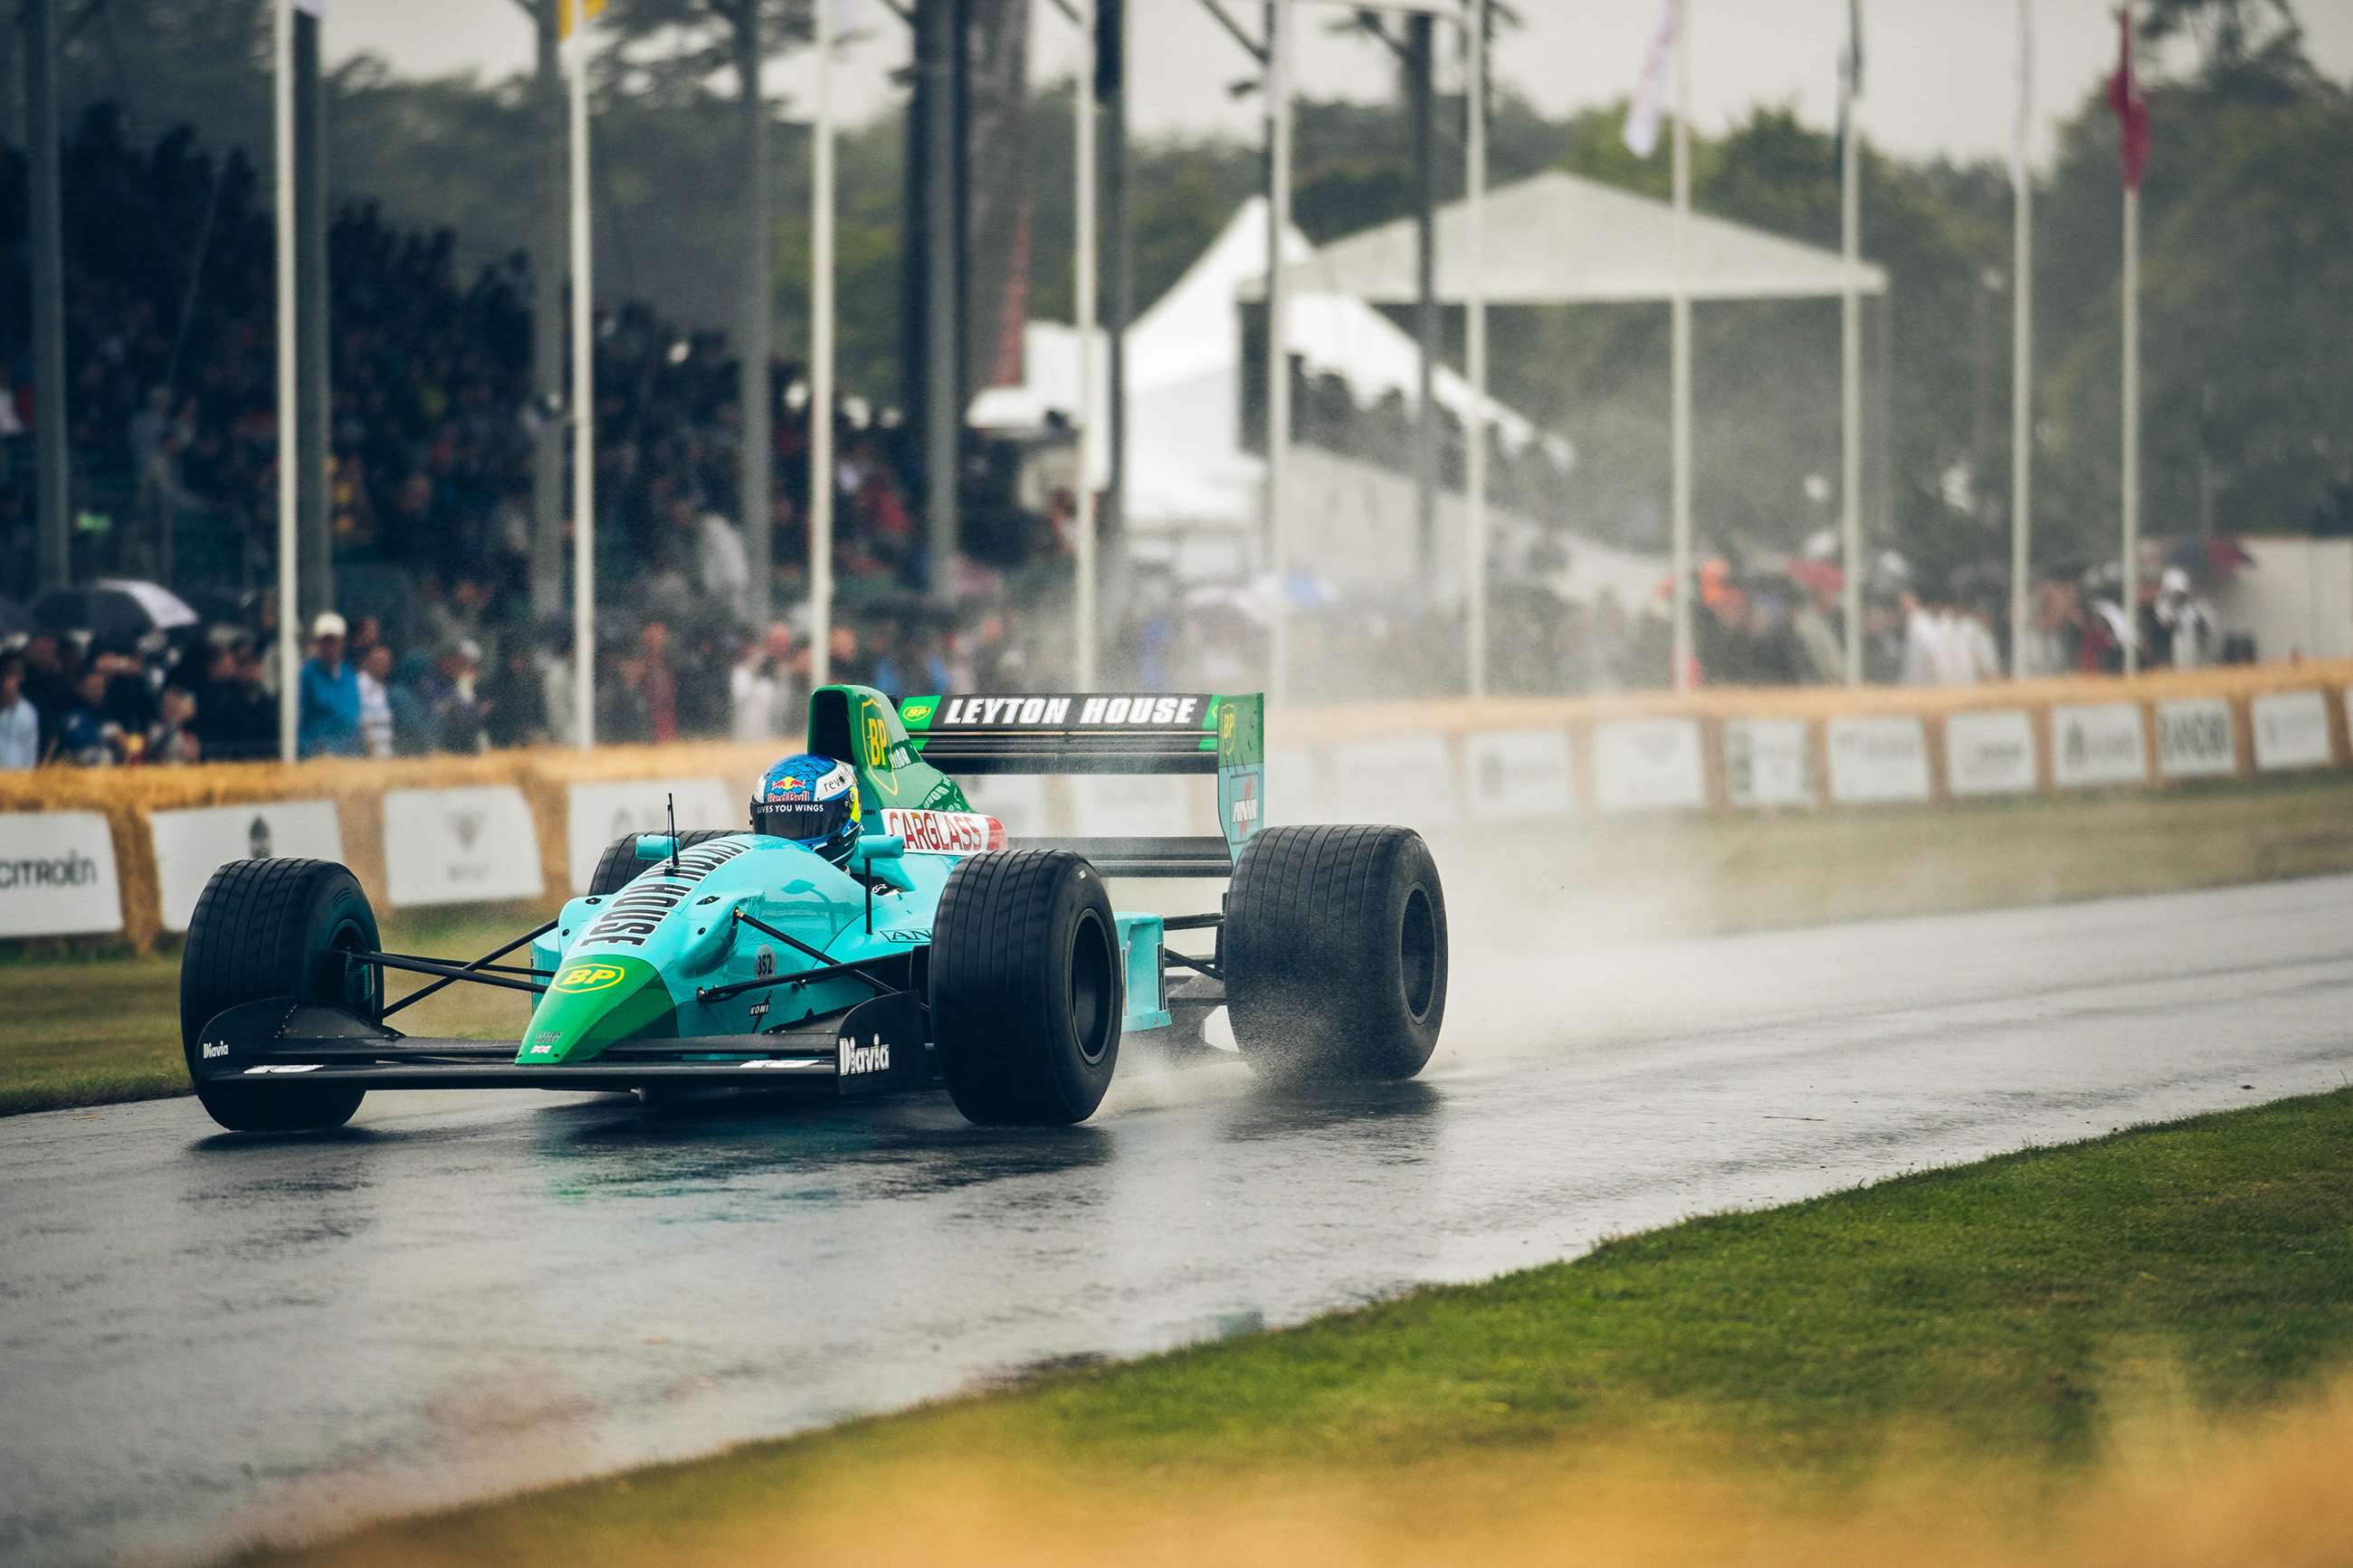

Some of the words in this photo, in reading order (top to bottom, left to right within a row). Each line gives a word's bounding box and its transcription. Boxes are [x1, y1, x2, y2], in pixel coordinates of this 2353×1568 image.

[908, 707, 929, 718] BP
[945, 698, 1072, 725] LEYTON
[1080, 698, 1198, 725] HOUSE
[1224, 713, 1234, 739] BP
[868, 717, 887, 767] BP
[757, 804, 774, 814] GIVES
[775, 804, 793, 813] YOU
[795, 803, 824, 813] WINGS
[767, 793, 788, 803] Red
[788, 791, 809, 803] Bull
[889, 811, 983, 851] CARGLASS
[579, 883, 692, 947] HOUSE
[757, 953, 773, 976] 352
[561, 969, 616, 985] BP
[203, 1040, 229, 1060] Diavia
[839, 1032, 890, 1076] Diavia
